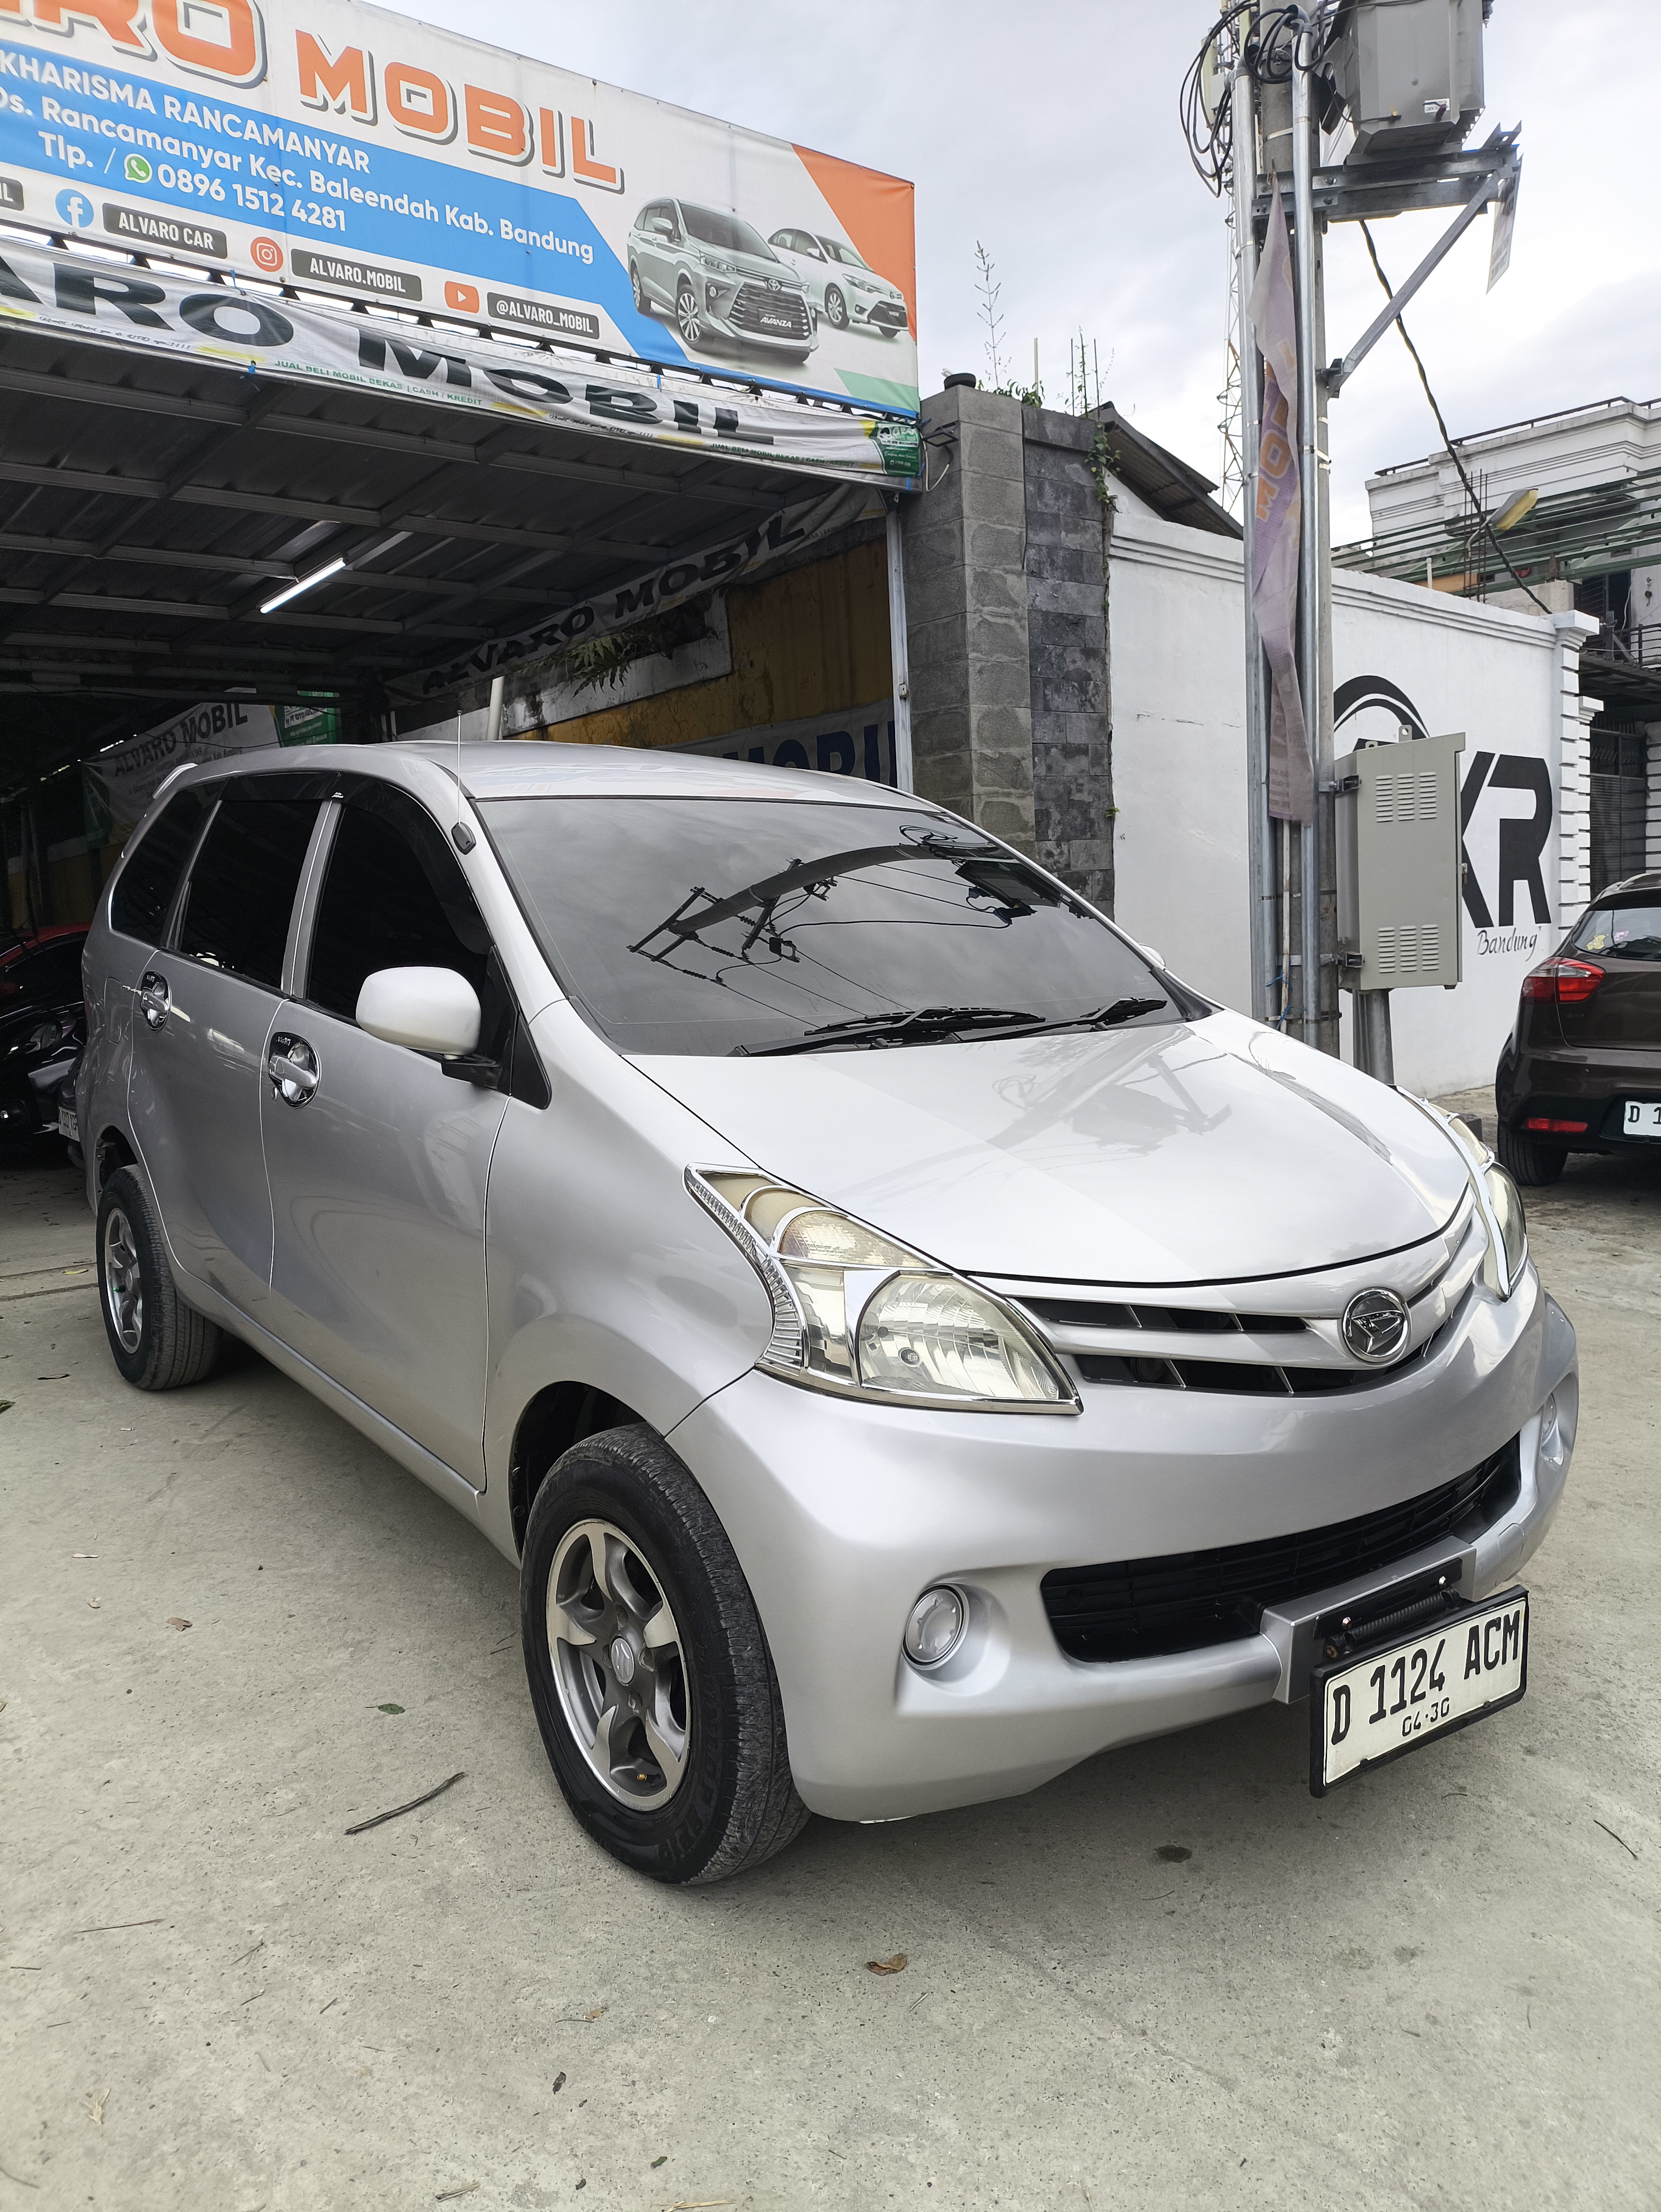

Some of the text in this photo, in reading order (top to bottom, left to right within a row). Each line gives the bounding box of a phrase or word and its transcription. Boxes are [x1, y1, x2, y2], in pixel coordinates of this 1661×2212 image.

[0, 49, 370, 174] KHARISMA RANCAMANYAR
[295, 29, 624, 193] MOBIL
[38, 131, 93, 169] Tlp.
[158, 164, 226, 201] 0896
[233, 184, 285, 217] 1512
[291, 196, 346, 232] 4281
[42, 96, 242, 172] Rancamanyar
[249, 154, 302, 189] Kec.
[311, 169, 439, 222] Baleendah
[444, 203, 494, 237] Kab.
[500, 218, 594, 264] Bandung
[119, 212, 214, 250] ALVARO CAR
[310, 258, 406, 293] ALVARO.MOBIL
[496, 300, 593, 333] @ALVARO_MOBIL
[760, 317, 792, 328] AVANZA
[275, 360, 303, 370] JUAL
[305, 365, 330, 376] BELI
[332, 371, 366, 383] MOBIL
[368, 377, 403, 390] BEKAS
[412, 387, 439, 397] CASH
[447, 393, 483, 406] KREDIT
[358, 329, 774, 445] MOBIL
[422, 515, 806, 695] ALVARO MOBIL
[114, 730, 176, 777] ALVARO
[181, 703, 248, 747] MOBIL
[1477, 927, 1538, 962] Bandung
[1628, 1105, 1640, 1123] D
[1331, 1684, 1351, 1745] D
[1369, 1638, 1446, 1725] 1124
[1464, 1610, 1520, 1680] ACM
